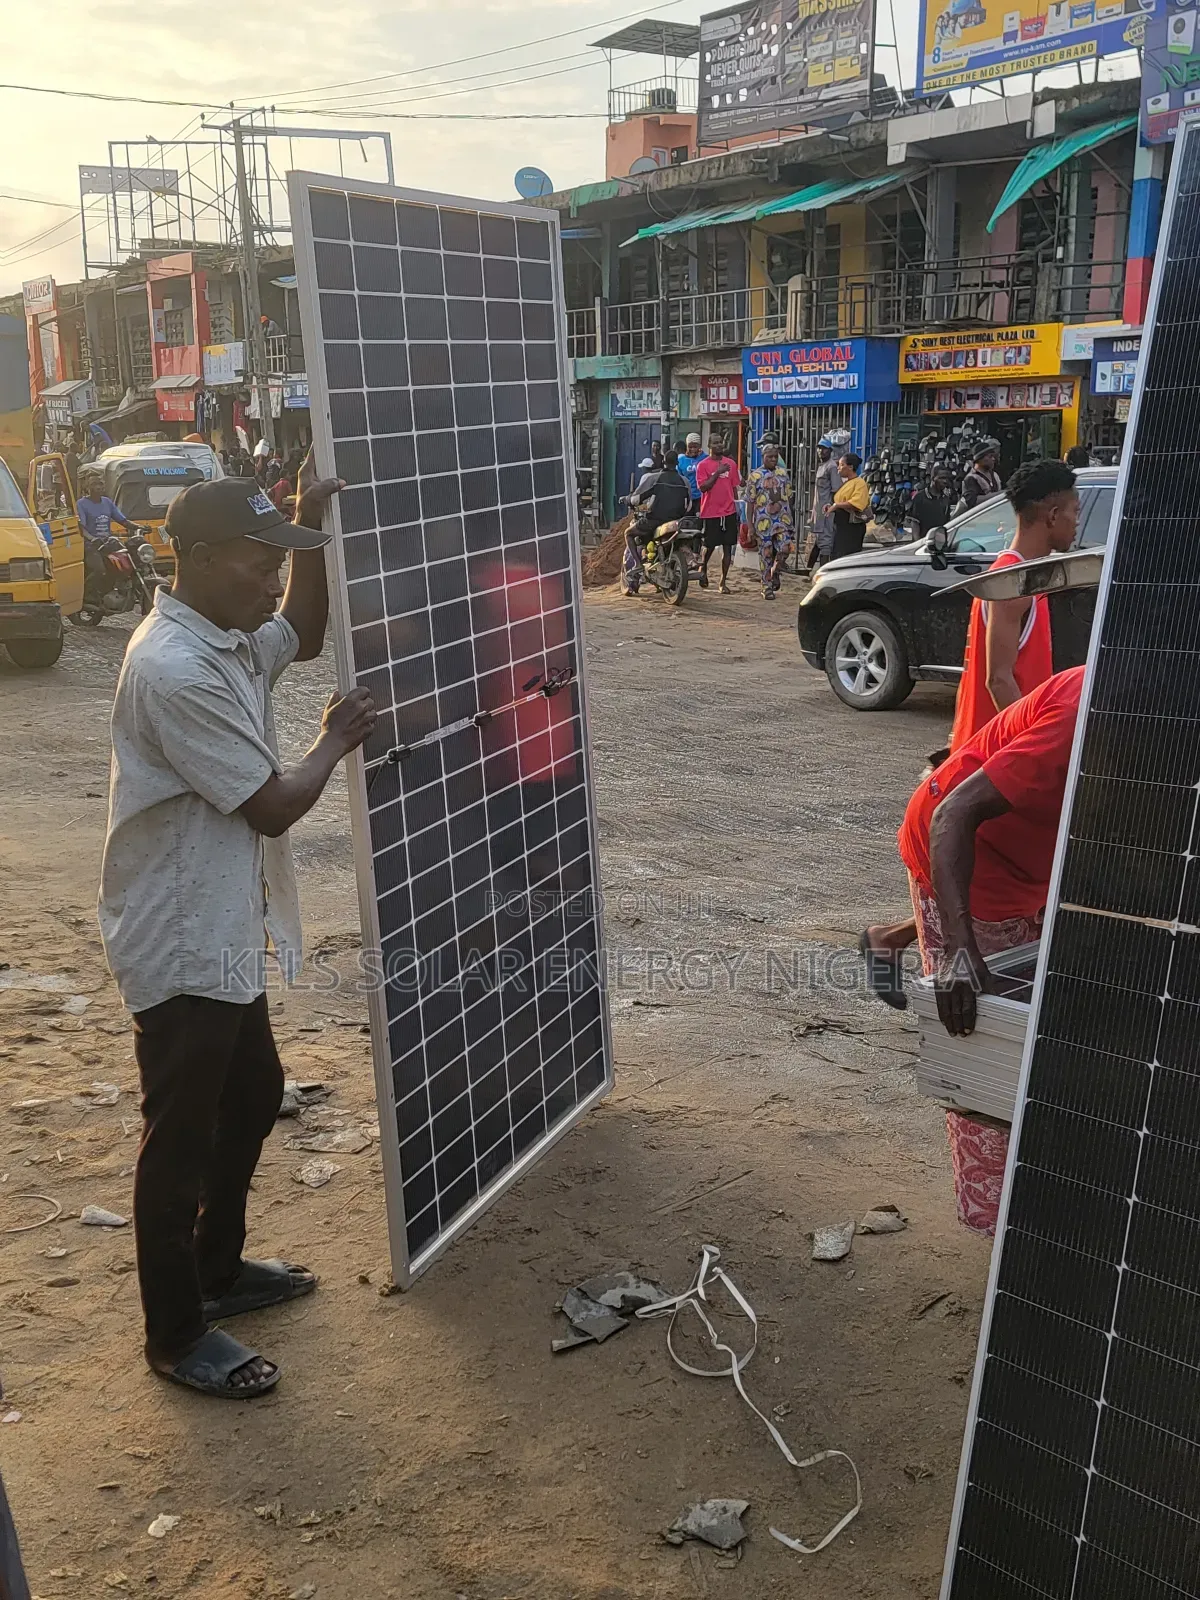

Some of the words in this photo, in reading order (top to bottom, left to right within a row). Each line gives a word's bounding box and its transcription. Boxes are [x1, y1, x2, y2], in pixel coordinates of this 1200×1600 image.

[711, 43, 740, 61] POWER
[743, 37, 761, 54] THAT
[932, 46, 941, 64] 8
[711, 60, 738, 77] NEVER
[925, 80, 943, 91] ONE
[946, 75, 957, 85] OF
[960, 71, 977, 82] THE
[980, 64, 1007, 78] MOST
[1010, 53, 1056, 71] TRUSTED
[1059, 43, 1094, 60] BRAND
[957, 332, 994, 344] ELECTRICAL
[997, 331, 1018, 341] PLAZA
[751, 351, 782, 365] CNN
[789, 345, 855, 363] GLOBAL
[757, 364, 792, 375] SOLAR
[708, 376, 729, 385] SAKO
